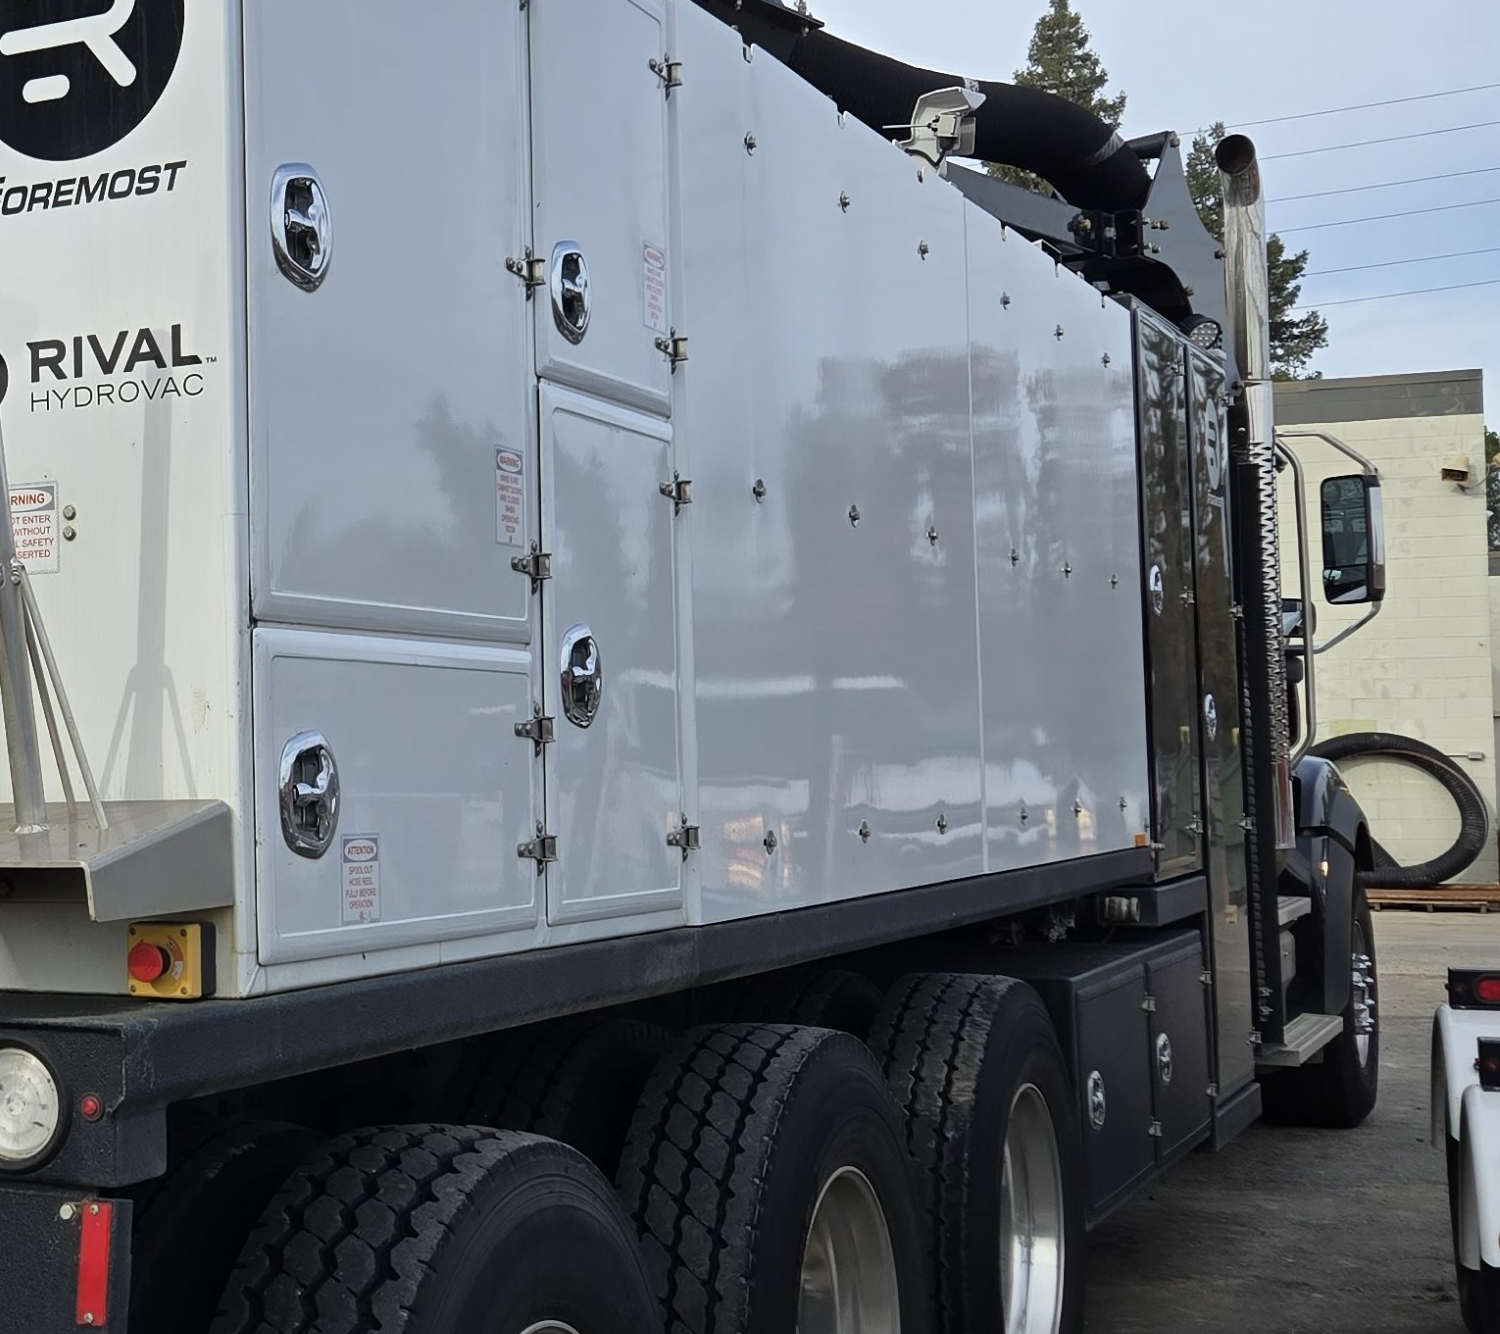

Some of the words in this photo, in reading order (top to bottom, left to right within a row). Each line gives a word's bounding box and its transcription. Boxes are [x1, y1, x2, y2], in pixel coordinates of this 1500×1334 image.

[26, 324, 202, 383] RIVAL
[30, 373, 204, 412] HYDROVAC
[10, 493, 45, 506] RNING
[22, 514, 51, 525] ENTER
[22, 537, 55, 548] SAFETY
[17, 549, 51, 559] SERTED
[347, 845, 374, 856] ATTENTION
[349, 899, 373, 910] OPERATION
